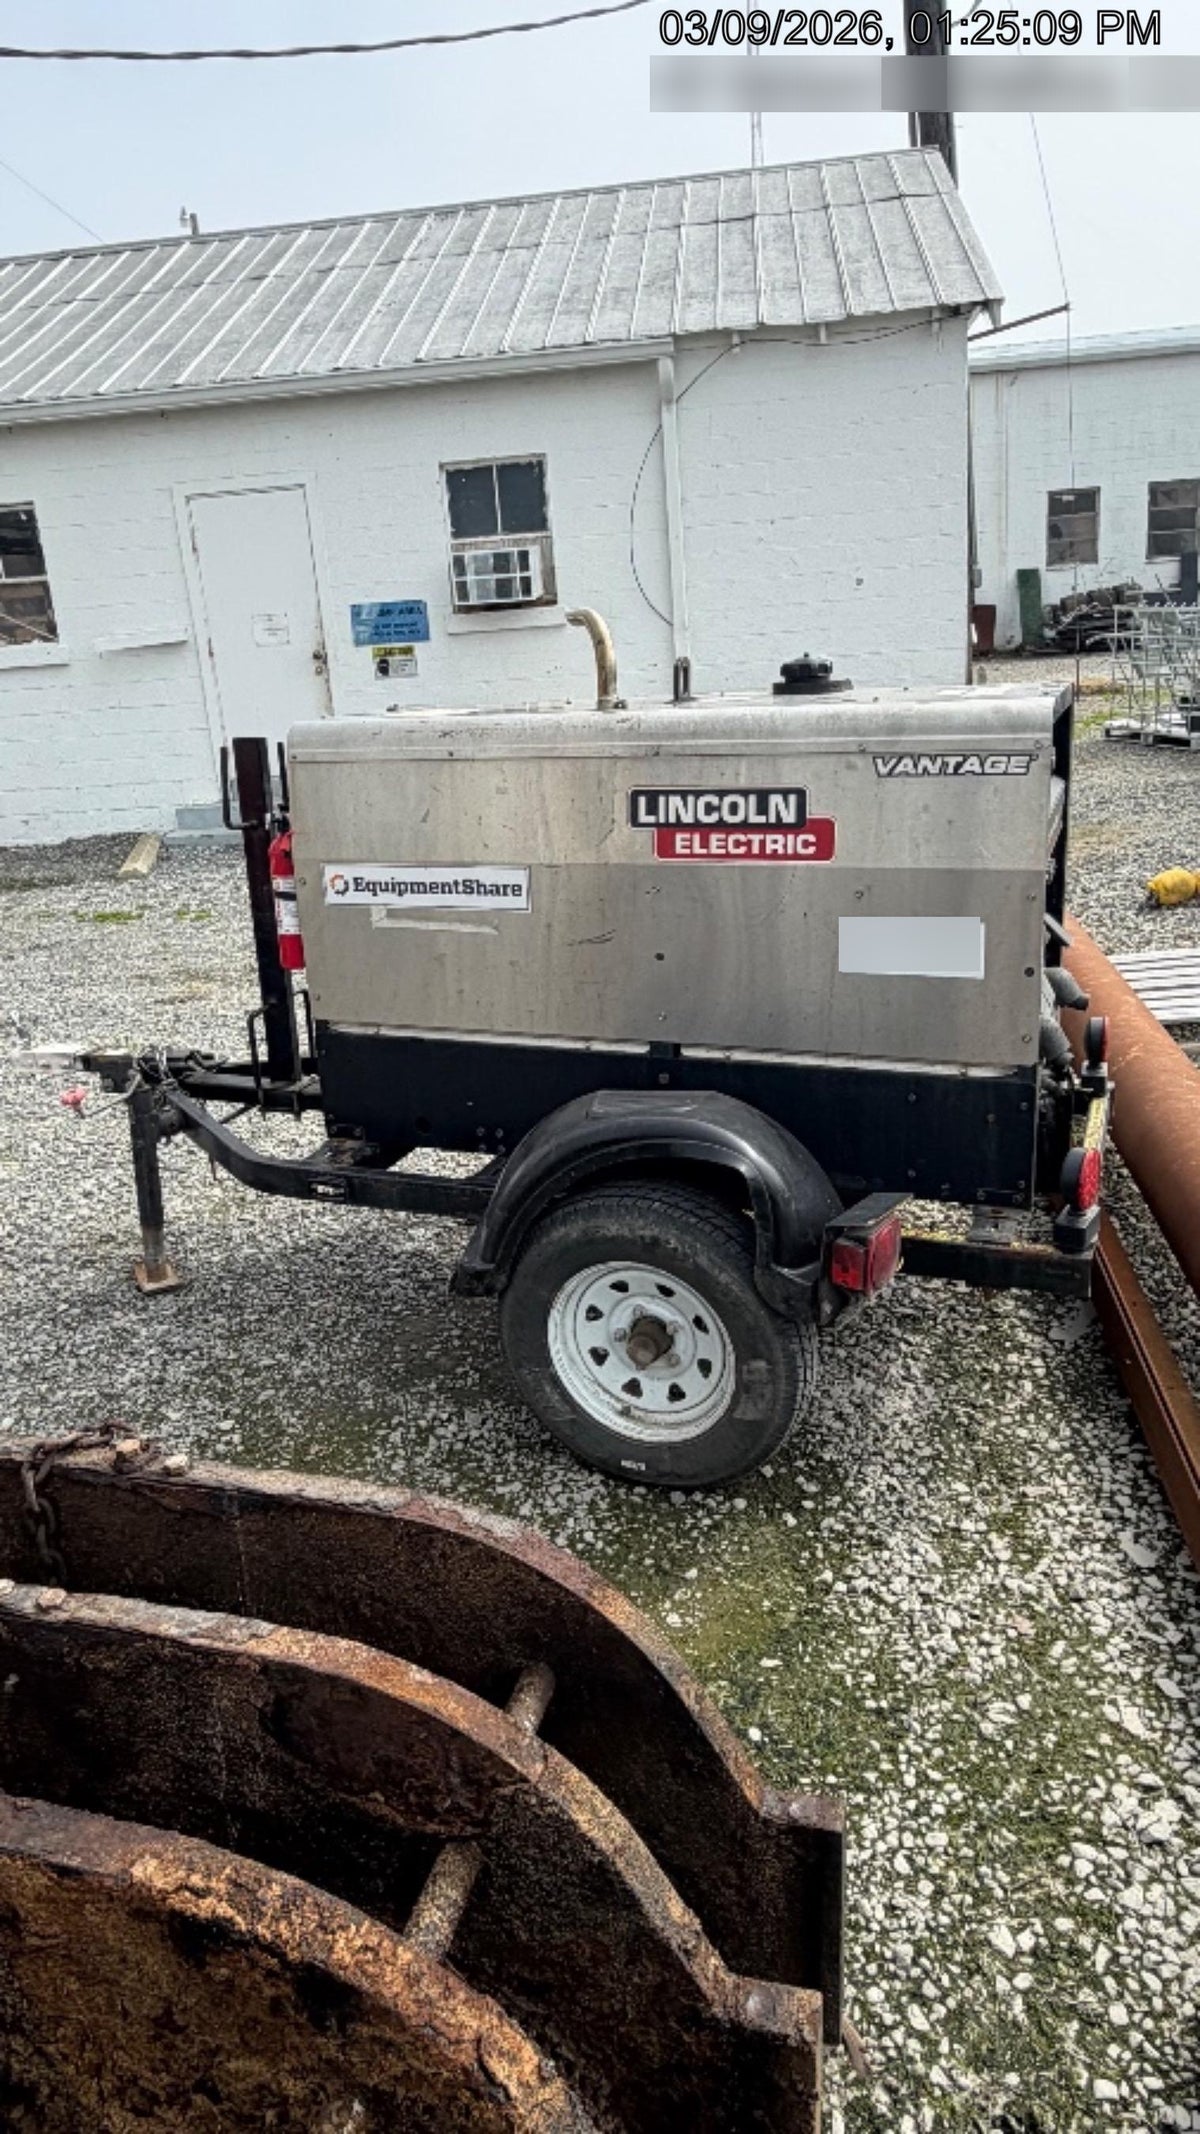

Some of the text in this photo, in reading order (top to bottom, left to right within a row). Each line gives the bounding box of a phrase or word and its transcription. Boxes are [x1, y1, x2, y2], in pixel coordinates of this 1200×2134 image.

[873, 753, 1032, 778] VANTAGE
[636, 793, 798, 824] LINCOLN
[674, 832, 817, 855] ELECTRIC
[352, 876, 523, 897] EquipmentShare
